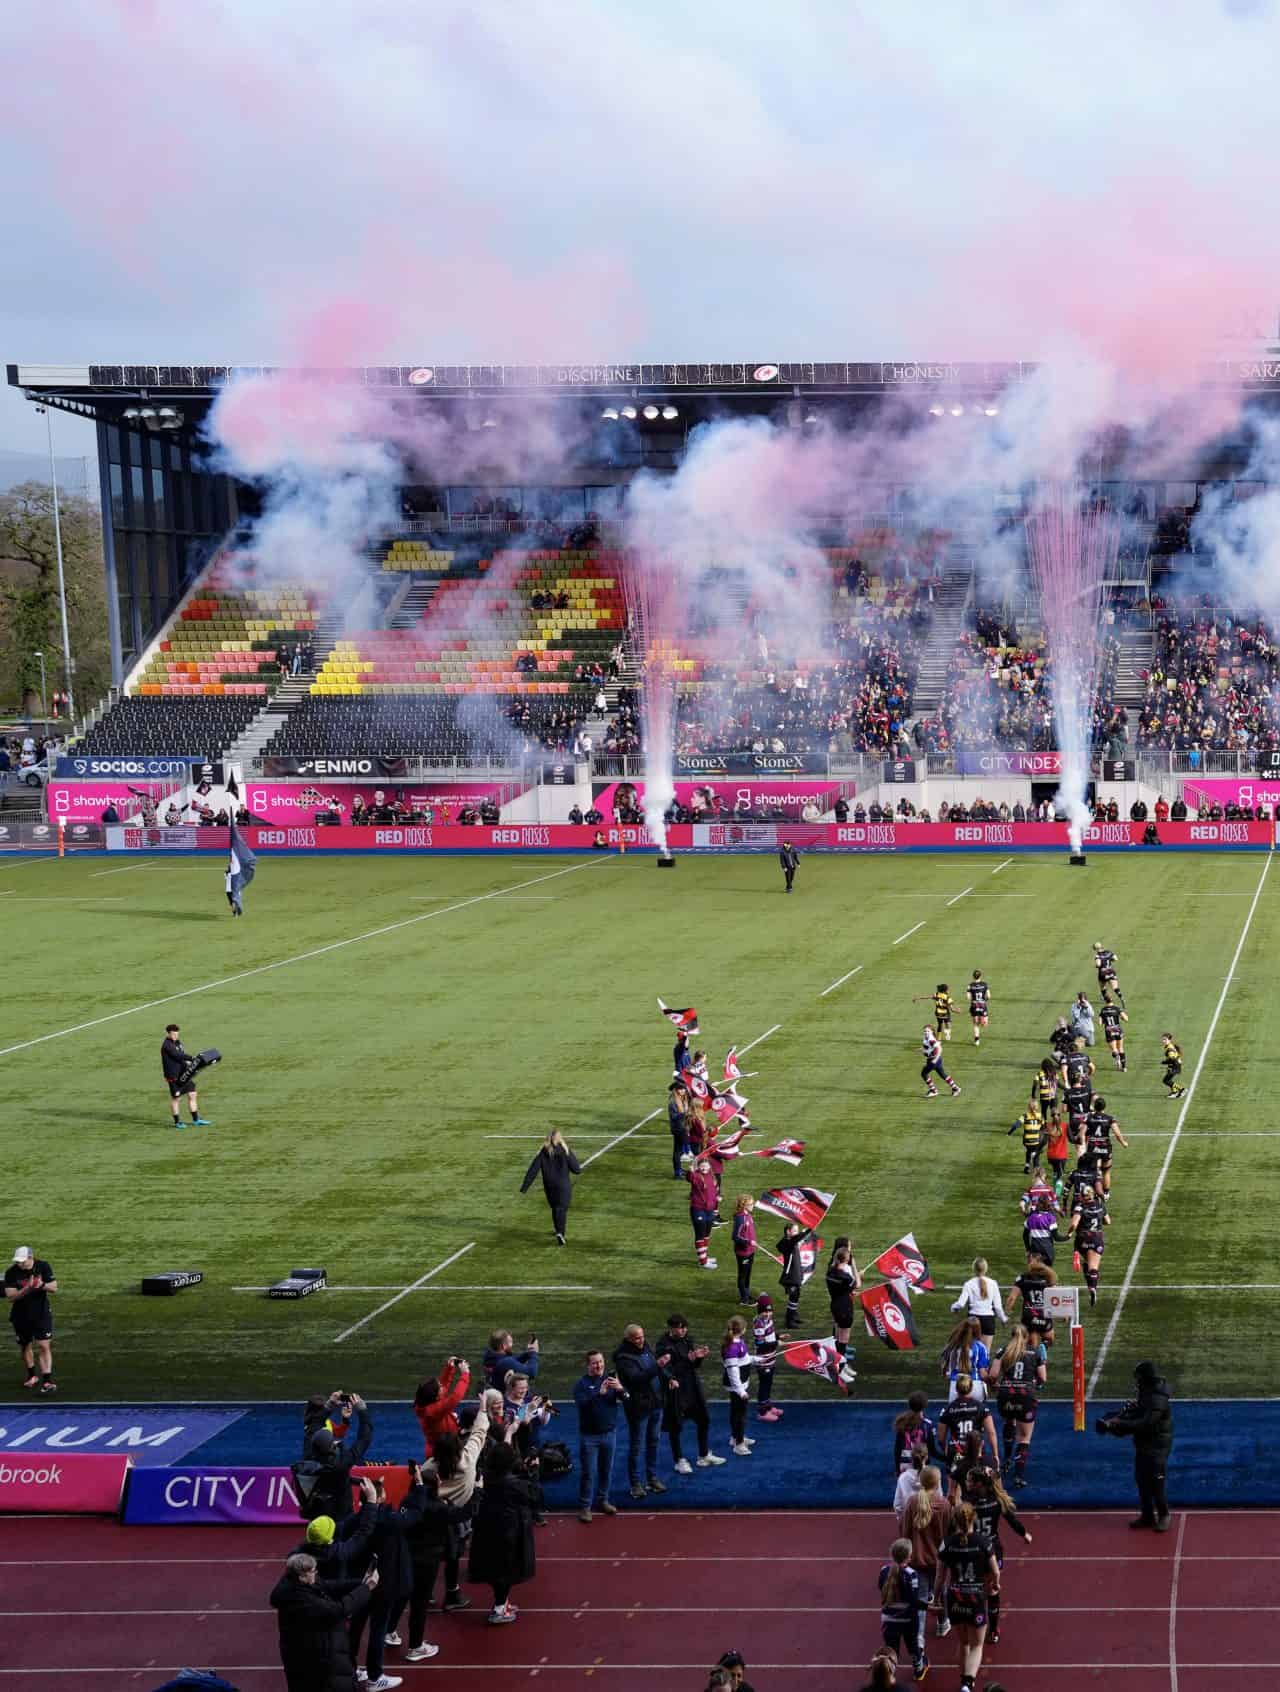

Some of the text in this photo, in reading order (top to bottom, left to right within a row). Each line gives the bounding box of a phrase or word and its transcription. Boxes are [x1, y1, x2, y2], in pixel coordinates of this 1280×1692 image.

[558, 368, 633, 382] DISCIPLINE
[894, 367, 960, 379] HONESTY
[91, 760, 185, 774] socios.com
[678, 756, 727, 768] StoneX
[754, 756, 803, 769] StoneX
[980, 756, 1062, 770] CITY INDEX
[755, 794, 820, 806] shawbrook
[258, 829, 315, 847] RED ROSES
[375, 828, 433, 847] RED ROSES
[492, 827, 549, 846] RED ROSES
[838, 826, 896, 843] RED ROSES
[954, 825, 1012, 842] RED ROSES
[1102, 824, 1130, 842] ROSES
[1190, 824, 1248, 841] RED ROSES
[1090, 1218, 1098, 1231] 2
[1029, 1289, 1044, 1304] 13
[1013, 1361, 1024, 1380] 8
[957, 1419, 974, 1433] 10
[165, 1476, 256, 1508] CITY
[957, 1561, 976, 1583] 14
